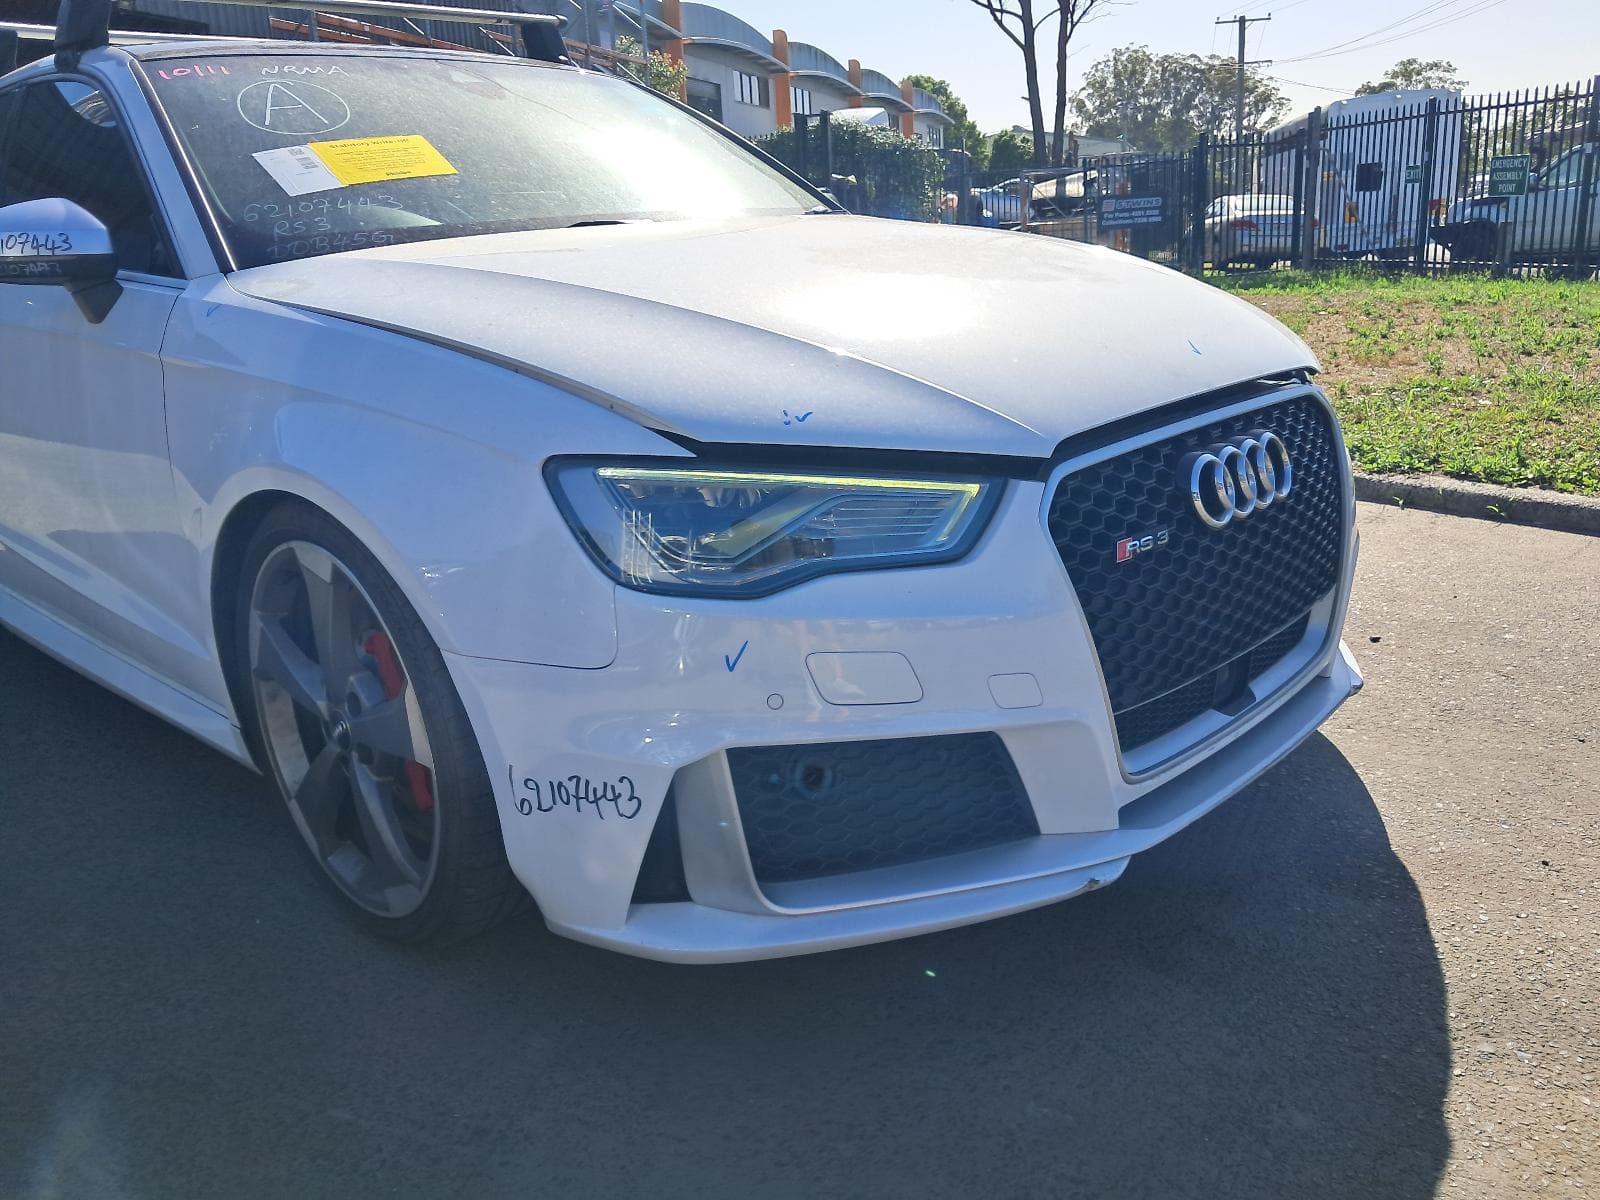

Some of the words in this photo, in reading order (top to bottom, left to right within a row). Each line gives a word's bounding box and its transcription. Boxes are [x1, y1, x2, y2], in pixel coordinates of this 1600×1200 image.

[1492, 158, 1528, 169] EMERGENCY
[1492, 171, 1523, 181] ASSEMBLY
[1498, 183, 1517, 193] POINT
[1125, 535, 1154, 558] RS
[1157, 529, 1169, 545] 3
[508, 763, 642, 821] 62107443
